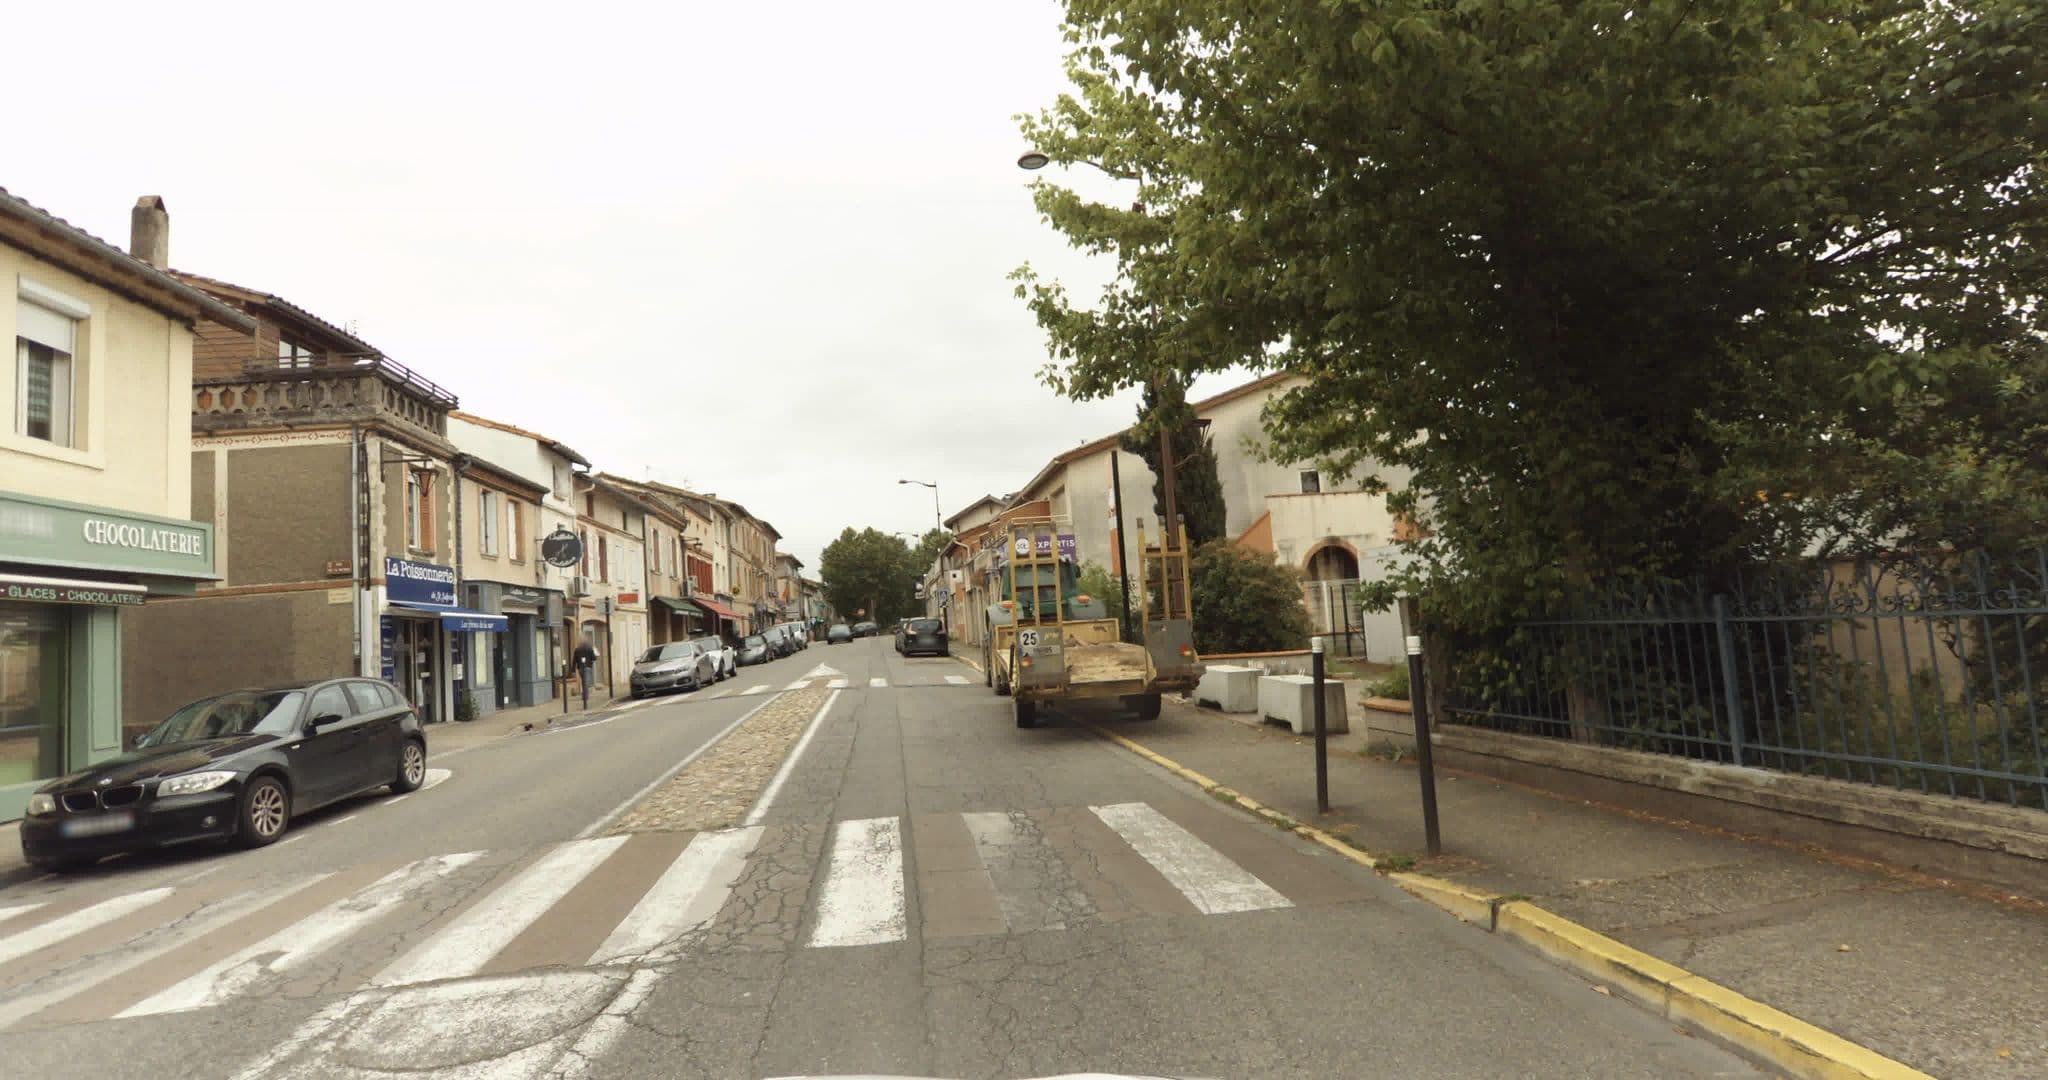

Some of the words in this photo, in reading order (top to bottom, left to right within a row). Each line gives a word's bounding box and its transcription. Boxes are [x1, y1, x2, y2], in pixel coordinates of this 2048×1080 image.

[83, 519, 202, 556] CHOCOLATERIE
[386, 558, 400, 576] La
[400, 561, 454, 584] Poissonnerie
[8, 585, 57, 601] GLACES
[67, 590, 145, 605] CHOCOLATERIE
[1022, 632, 1037, 646] 25
